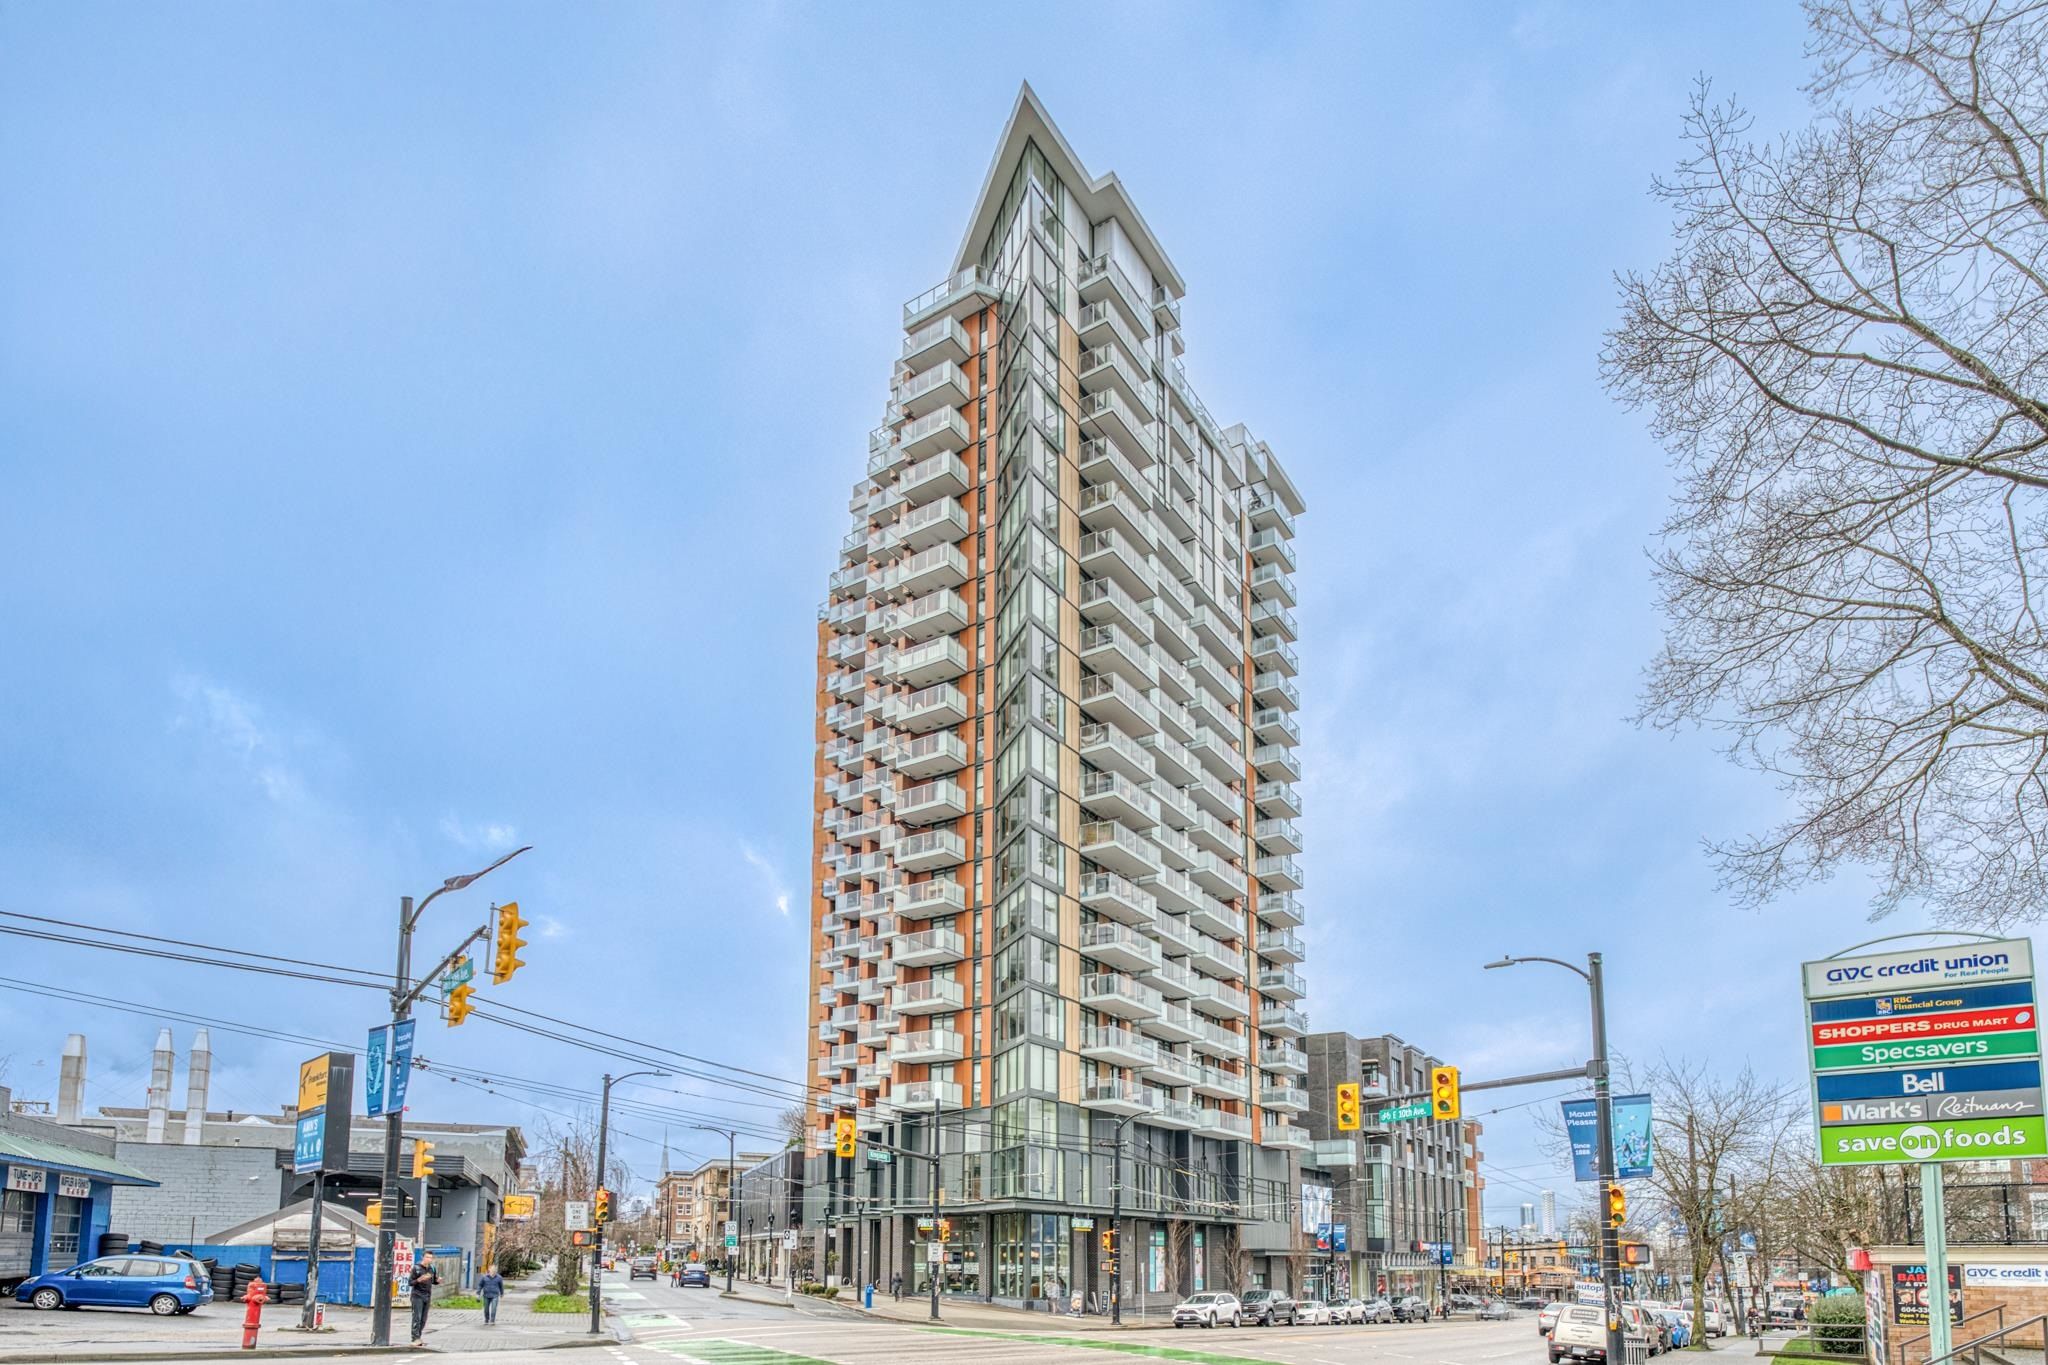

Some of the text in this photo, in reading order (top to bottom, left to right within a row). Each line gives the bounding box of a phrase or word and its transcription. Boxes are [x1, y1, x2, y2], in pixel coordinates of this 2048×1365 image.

[1877, 958, 1939, 977] credit
[1945, 953, 2009, 970] union
[1944, 966, 2009, 979] For Real People
[1893, 996, 1912, 1004] RBC
[1893, 998, 1963, 1011] Financial Group
[1818, 1016, 2009, 1040] SHOPPERS DRUG MART
[1861, 1040, 1988, 1063] Specsavers
[1902, 1072, 1945, 1094] Bell
[1392, 1107, 1427, 1119] E 10th Ave.
[1841, 1102, 1923, 1121] Mark's
[1936, 1095, 2035, 1118] Reitmans
[1568, 1110, 1597, 1118] Mount
[1838, 1126, 2026, 1152] save on foods
[13, 1168, 42, 1182] TUNE-UPS
[727, 1224, 736, 1232] 30
[2000, 1268, 2042, 1277] credit
